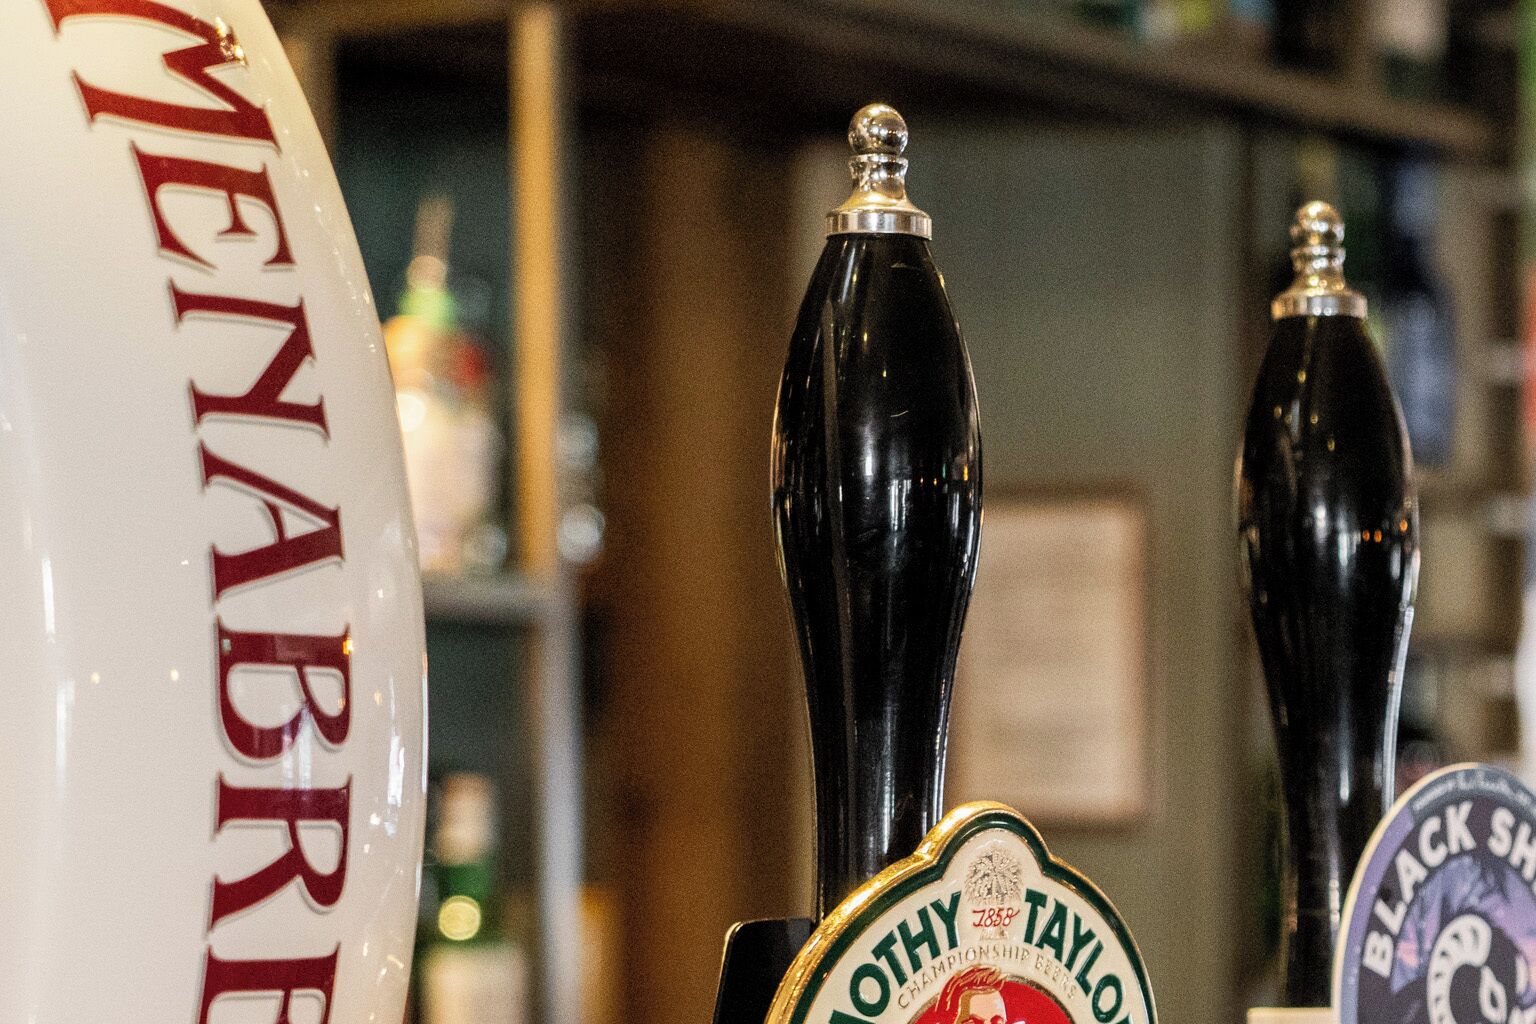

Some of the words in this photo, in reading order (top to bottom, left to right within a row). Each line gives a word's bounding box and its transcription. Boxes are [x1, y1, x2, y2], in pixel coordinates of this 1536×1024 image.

[971, 906, 1020, 928] 1858
[1362, 800, 1477, 978] BLACK
[897, 944, 1031, 1010] CHAMPIONSHIP
